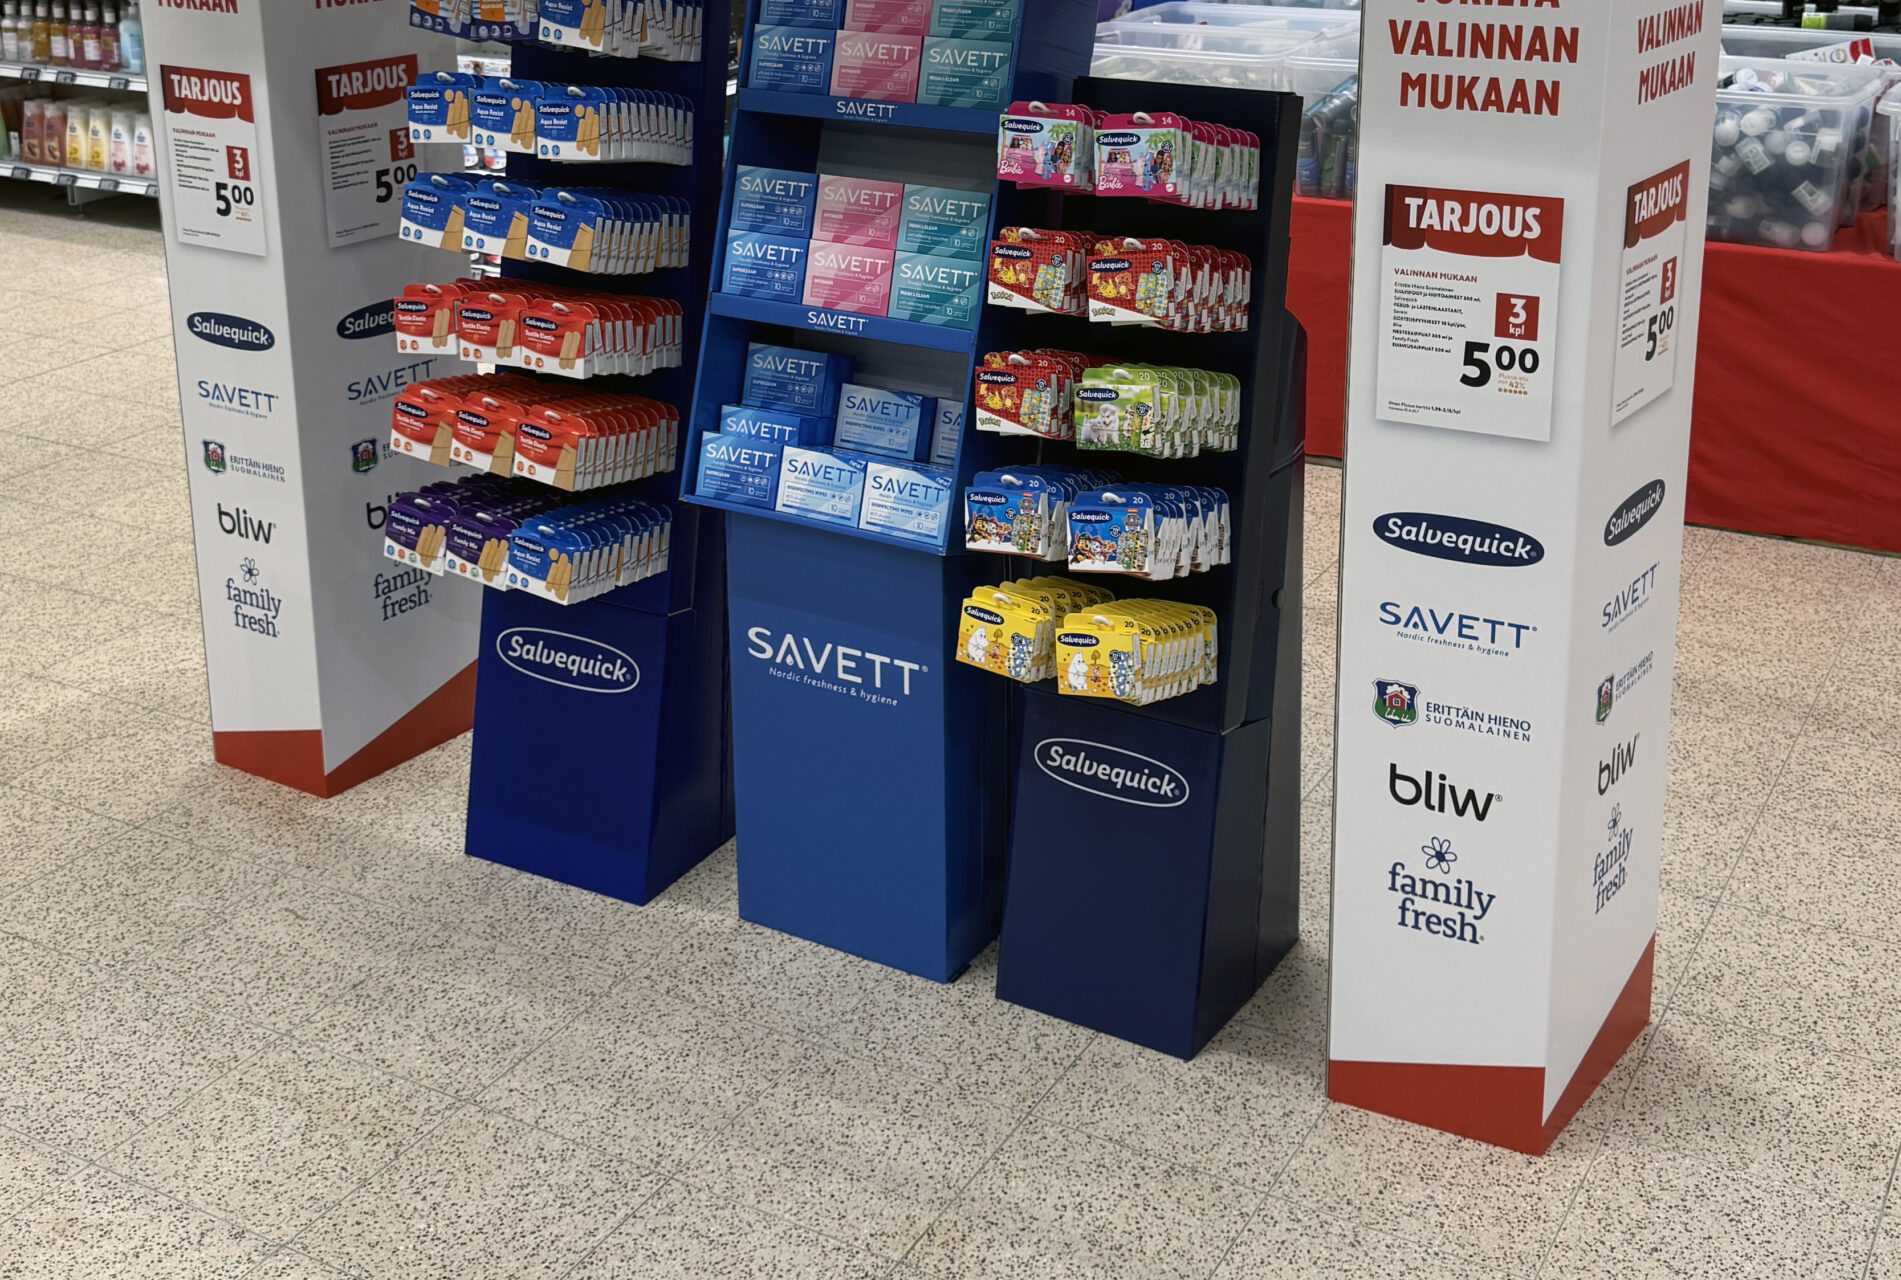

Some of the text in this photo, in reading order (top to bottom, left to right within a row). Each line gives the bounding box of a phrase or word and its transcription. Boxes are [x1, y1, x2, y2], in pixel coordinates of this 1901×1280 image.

[1638, 0, 1704, 53] VALINNAN
[759, 36, 827, 54] SAVETT
[1388, 19, 1579, 63] VALINNAN
[170, 74, 242, 105] TARJOUS
[327, 63, 408, 98] TARJOUS
[1638, 51, 1695, 105] MUKAAN
[410, 91, 440, 99] Salvequick
[476, 96, 507, 105] Salvequick
[1400, 72, 1560, 116] MUKAAN
[1065, 109, 1075, 117] 14
[1161, 117, 1172, 125] 14
[1003, 121, 1041, 132] Salvequick
[397, 130, 407, 149] 3
[1100, 135, 1138, 144] Salvequick
[233, 150, 243, 167] 3
[740, 177, 809, 197] SAVETT
[1098, 176, 1123, 190] Barbie
[824, 187, 894, 207] SAVETT
[909, 196, 981, 218] SAVETT
[1634, 173, 1683, 224] TARJOUS
[1405, 197, 1541, 239] TARJOUS
[732, 241, 800, 262] SAVETT
[814, 252, 886, 274] SAVETT
[995, 246, 1031, 258] Salvequick
[900, 264, 974, 286] SAVETT
[1092, 261, 1129, 270] Salvequick
[1394, 268, 1477, 283] VALINNAN MUKAAN
[1665, 263, 1673, 288] 3
[397, 303, 427, 311] Salvequick
[1509, 298, 1527, 324] 3
[193, 317, 268, 345] Salvequick
[808, 311, 865, 331] SAVETT
[1509, 324, 1525, 337] kpl
[753, 354, 820, 377] SAVETT
[979, 373, 1015, 383] Salvequick
[347, 360, 433, 400] SAVETT
[198, 380, 275, 412] SAVETT
[846, 395, 914, 419] SAVETT
[1078, 391, 1117, 399] Salvequick
[396, 402, 427, 417] Salvequick
[726, 418, 793, 440] SAVETT
[706, 444, 773, 467] SAVETT
[788, 459, 856, 484] SAVETT
[872, 476, 944, 502] SAVETT
[970, 494, 1006, 503] Salvequick
[391, 511, 419, 525] Salvequick
[1072, 513, 1110, 521] Salvequick
[1608, 481, 1662, 540] Salvequick
[217, 503, 272, 544] bliw
[454, 536, 467, 545] Family
[1385, 518, 1532, 560] Salvequick
[226, 579, 281, 620] family
[382, 594, 429, 620] fresh
[1602, 562, 1657, 628] SAVETT
[234, 605, 277, 637] fresh
[966, 607, 1001, 623] Salvequick
[1379, 602, 1530, 648] SAVETT
[1060, 635, 1097, 645] Salvequick
[1397, 631, 1424, 643] Nordic
[1427, 635, 1465, 649] freshness
[1476, 644, 1509, 657] hygiene
[508, 636, 627, 682] Salvequick
[748, 627, 919, 695] SAVETT
[1616, 651, 1654, 691] ERITTÄIN HIENO
[769, 667, 898, 707] Nordic freshness & hygiene
[1425, 713, 1530, 742] SUOMALAINEN
[1426, 702, 1485, 722] ERITTÄIN
[1488, 714, 1531, 732] HIENO
[1046, 746, 1176, 797] Salvequick
[1597, 734, 1637, 795] bliw
[1389, 763, 1494, 822] bliw
[1593, 828, 1633, 886] family
[1388, 862, 1496, 921] family
[1595, 863, 1626, 914] fresh
[1398, 897, 1480, 944] fresh
